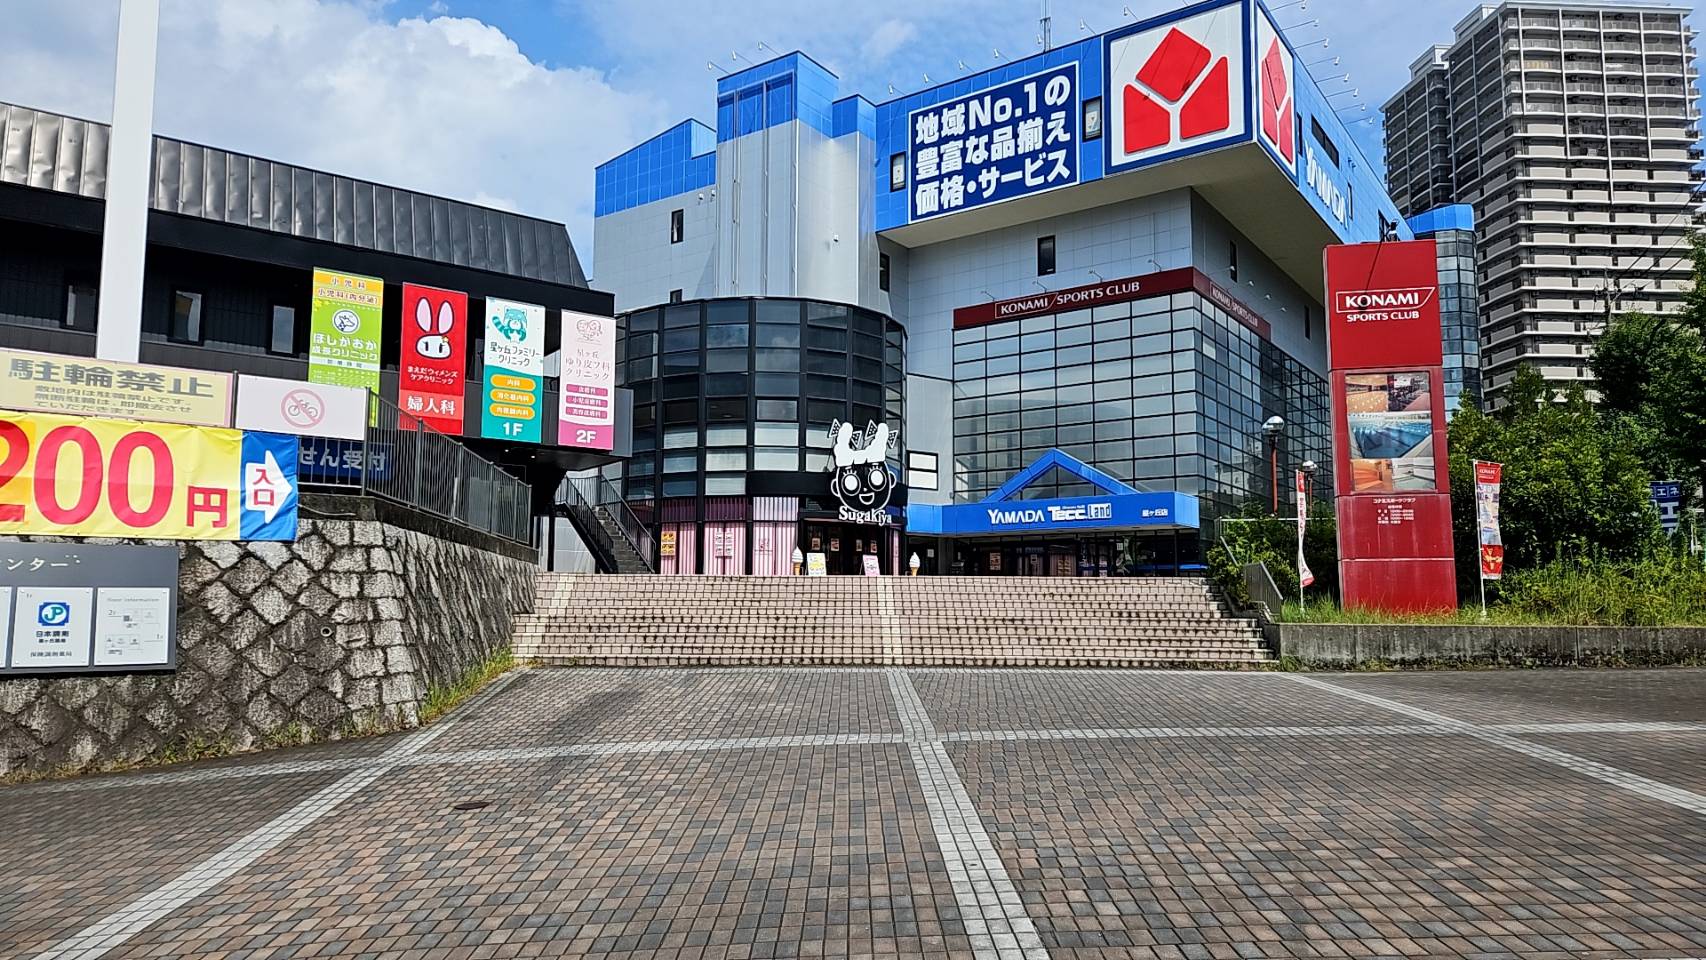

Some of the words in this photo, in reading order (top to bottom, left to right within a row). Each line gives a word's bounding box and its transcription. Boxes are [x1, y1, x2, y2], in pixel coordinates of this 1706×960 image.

[915, 75, 1071, 145] 地域No.1の
[915, 110, 1071, 181] 豊富な品揃え
[915, 149, 1071, 216] 価格・サービス
[1001, 297, 1048, 315] KONAMI
[1056, 287, 1103, 305] SPORTS
[1105, 281, 1140, 296] CLUB
[1345, 292, 1419, 308] KONAMI
[1346, 312, 1389, 323] SPORTS
[1390, 311, 1420, 320] CLUB
[498, 355, 531, 367] クリニック
[8, 357, 214, 399] 駐輪禁止
[410, 373, 454, 385] ケアクリニック
[565, 368, 610, 381] クリニック
[407, 395, 455, 415] 婦人科
[502, 422, 524, 437] 1F
[576, 430, 597, 443] 2F
[252, 468, 276, 507] 入口
[838, 505, 892, 526] Sugakiya
[987, 509, 1045, 524] YAMADA
[0, 557, 69, 572] ンター
